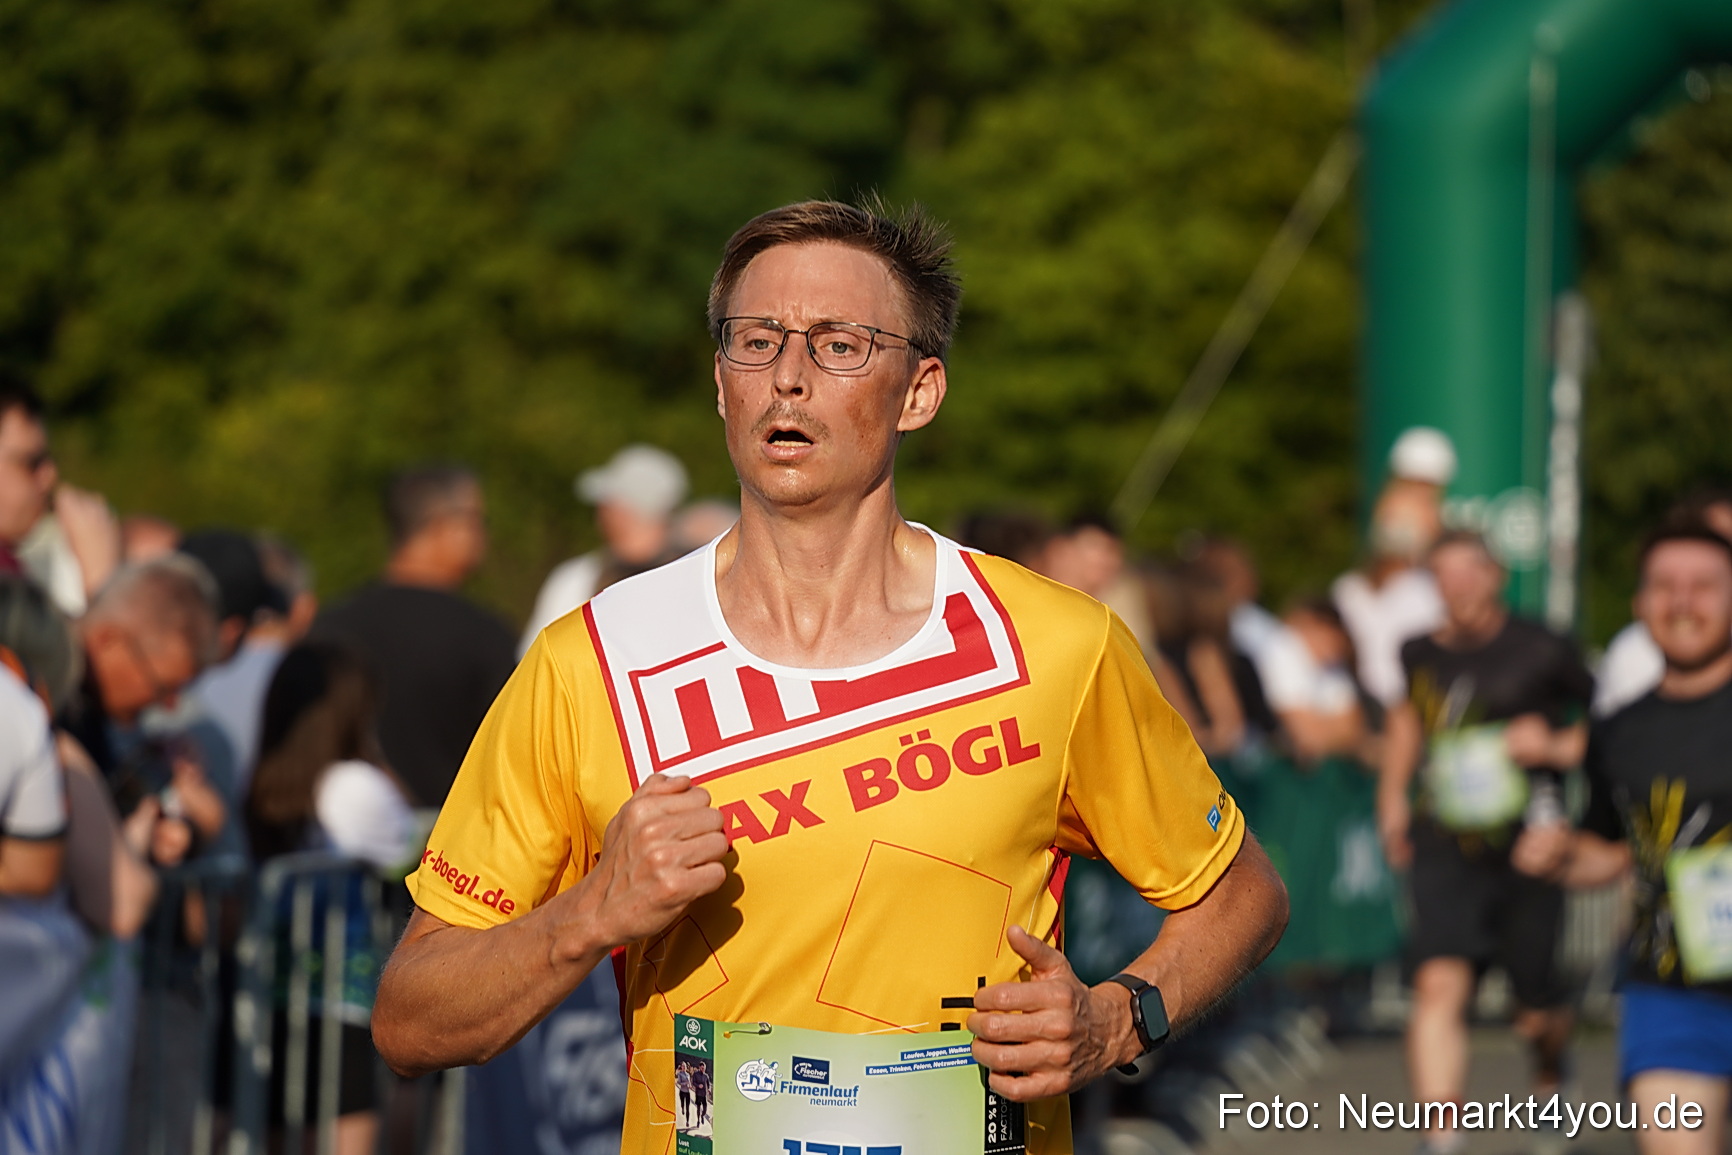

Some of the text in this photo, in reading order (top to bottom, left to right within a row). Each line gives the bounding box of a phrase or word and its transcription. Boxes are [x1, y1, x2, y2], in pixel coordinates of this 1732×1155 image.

[718, 716, 1041, 851] AX BÖGL
[421, 847, 515, 915] x-boegl.de
[678, 1034, 708, 1053] AOK
[903, 1052, 925, 1060] Laufen,
[948, 1046, 971, 1055] Walken
[780, 1080, 860, 1098] Firmenlauf
[809, 1097, 858, 1107] neumarkt
[988, 1107, 998, 1121] %
[987, 1121, 998, 1144] 20
